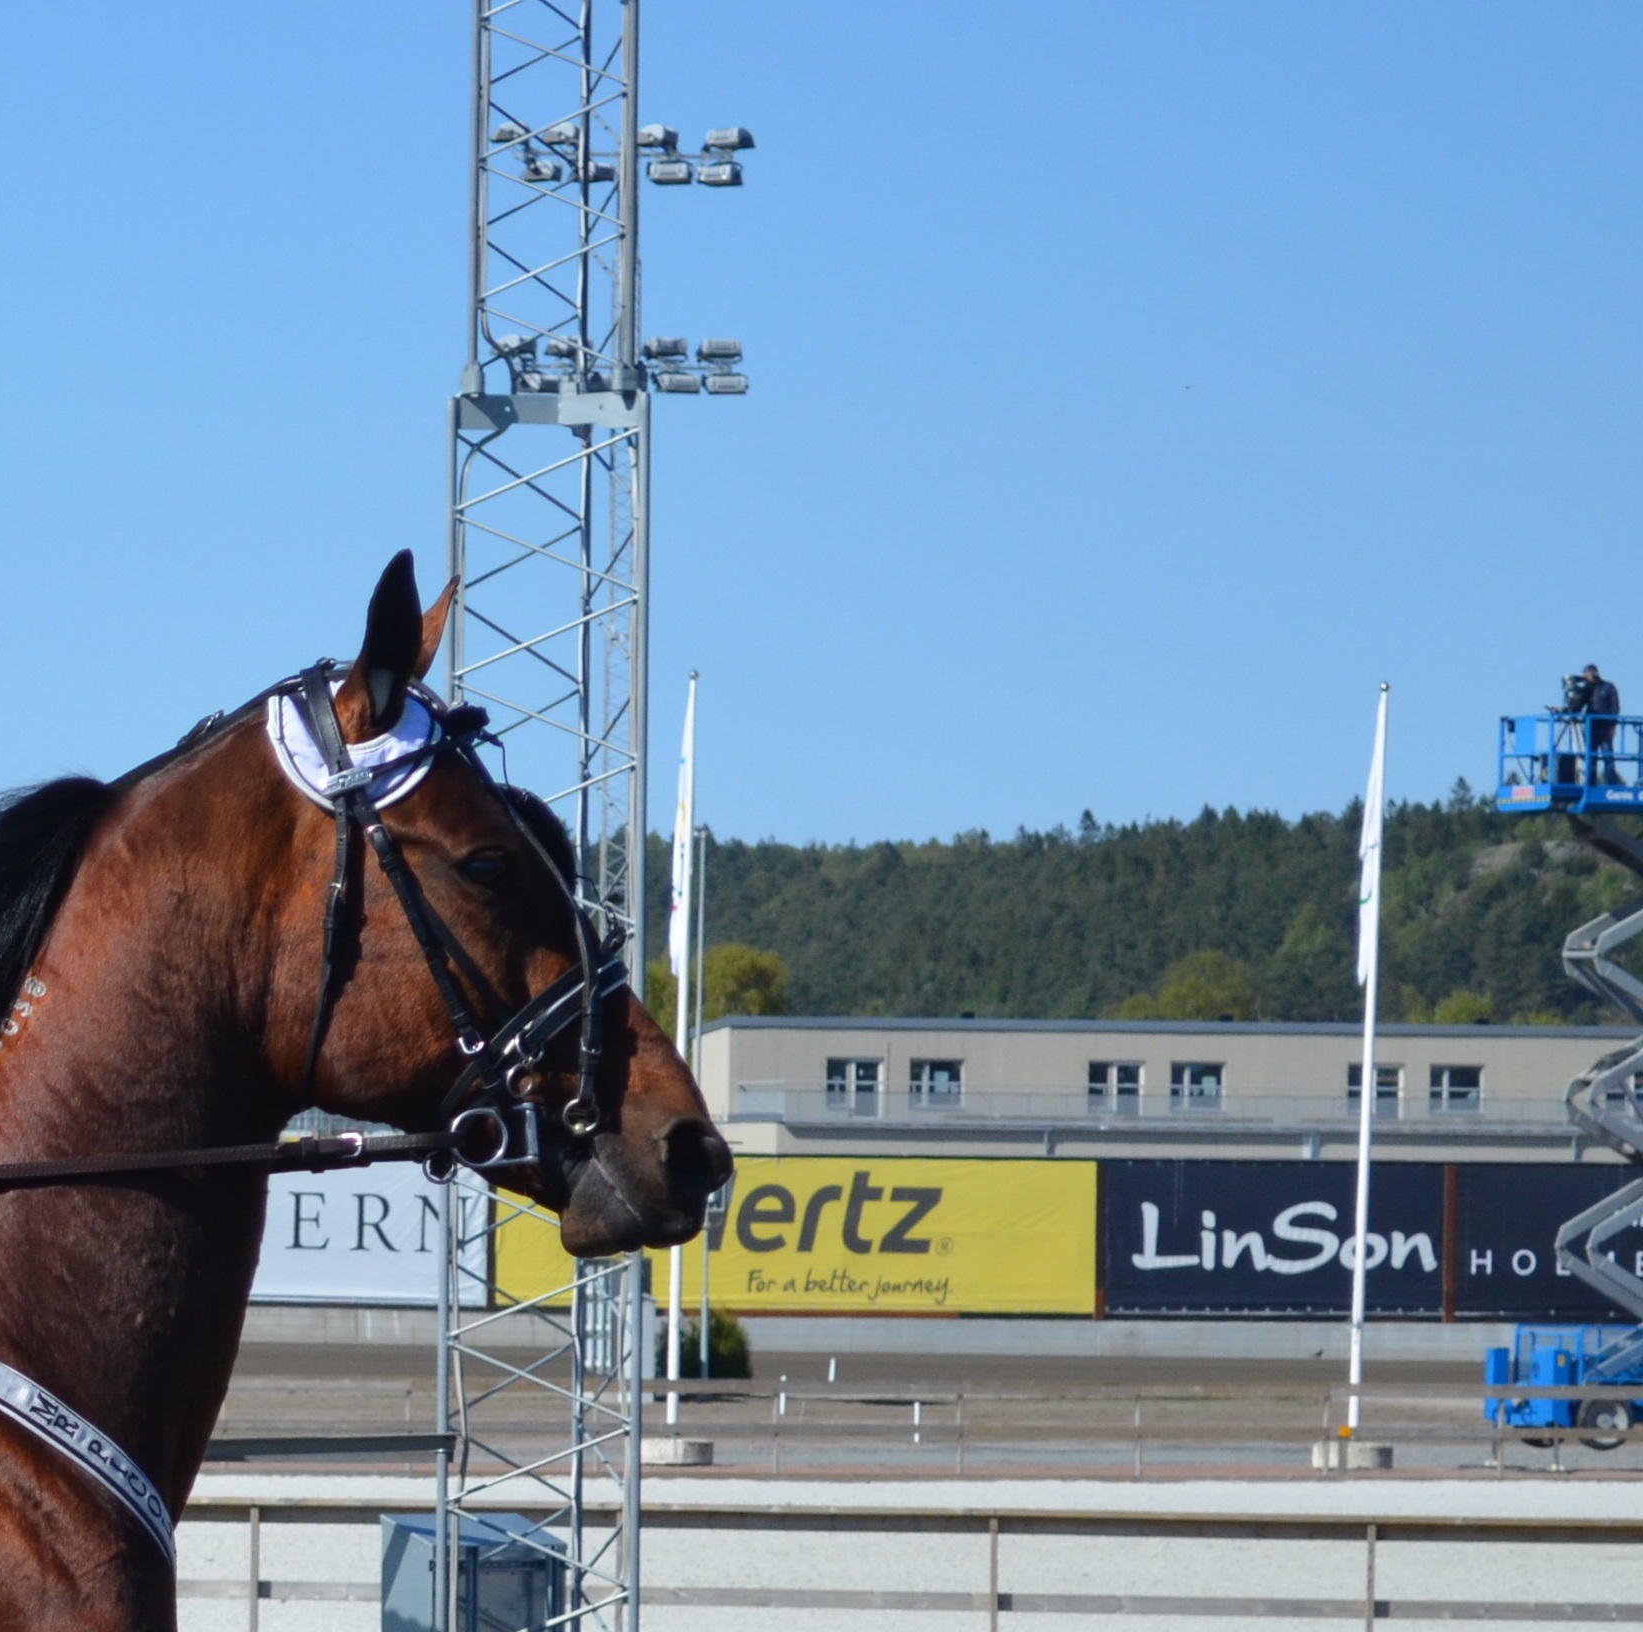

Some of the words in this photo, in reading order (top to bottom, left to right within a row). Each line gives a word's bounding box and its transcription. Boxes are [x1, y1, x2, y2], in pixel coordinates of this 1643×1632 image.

[1131, 1201, 1438, 1275] LinSon
[747, 1269, 777, 1293] For
[782, 1279, 797, 1293] a
[804, 1268, 870, 1293] better
[866, 1275, 954, 1305] journey.
